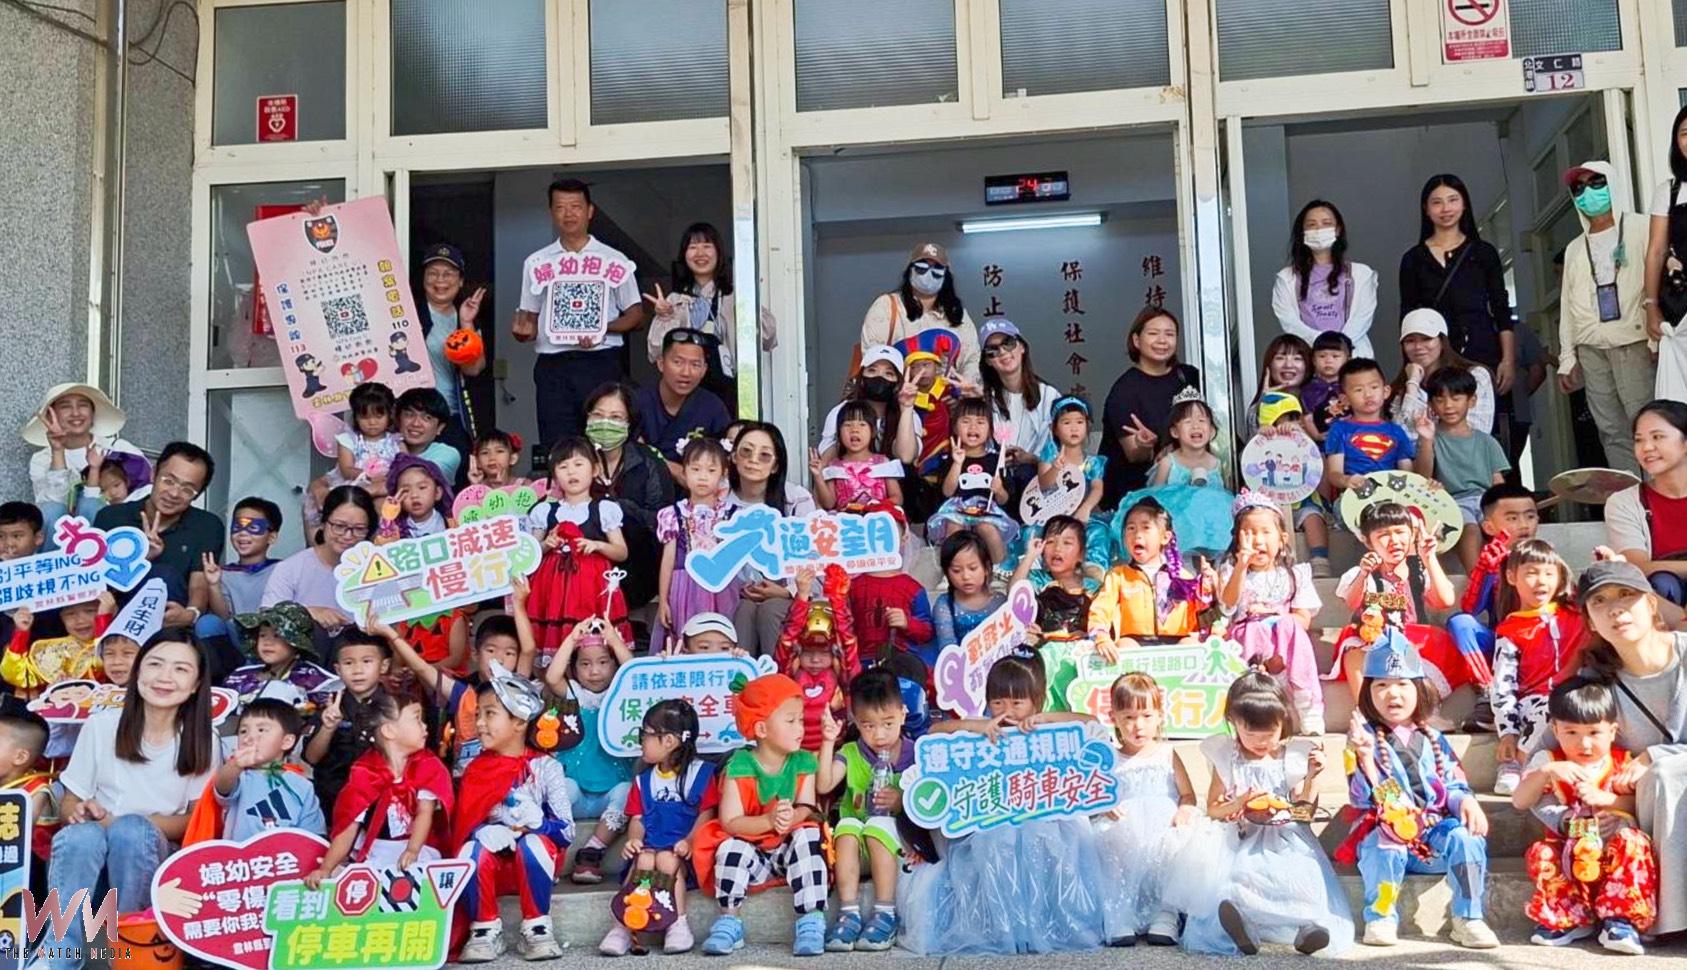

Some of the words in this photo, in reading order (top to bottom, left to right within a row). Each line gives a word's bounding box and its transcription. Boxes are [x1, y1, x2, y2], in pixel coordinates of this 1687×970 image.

[1547, 73, 1575, 89] 12
[533, 255, 626, 285] 婦幼抱抱
[983, 264, 1005, 317] 防止
[392, 319, 409, 330] 110
[387, 517, 518, 572] 路口減速
[426, 553, 508, 600] 慢行
[923, 730, 1081, 773] 遵守交通規則
[953, 767, 1113, 820] 守護騎車安全
[198, 851, 300, 888] 婦幼安全
[273, 888, 330, 921] 看到
[346, 879, 369, 905] 停
[287, 920, 437, 966] 停車再開
